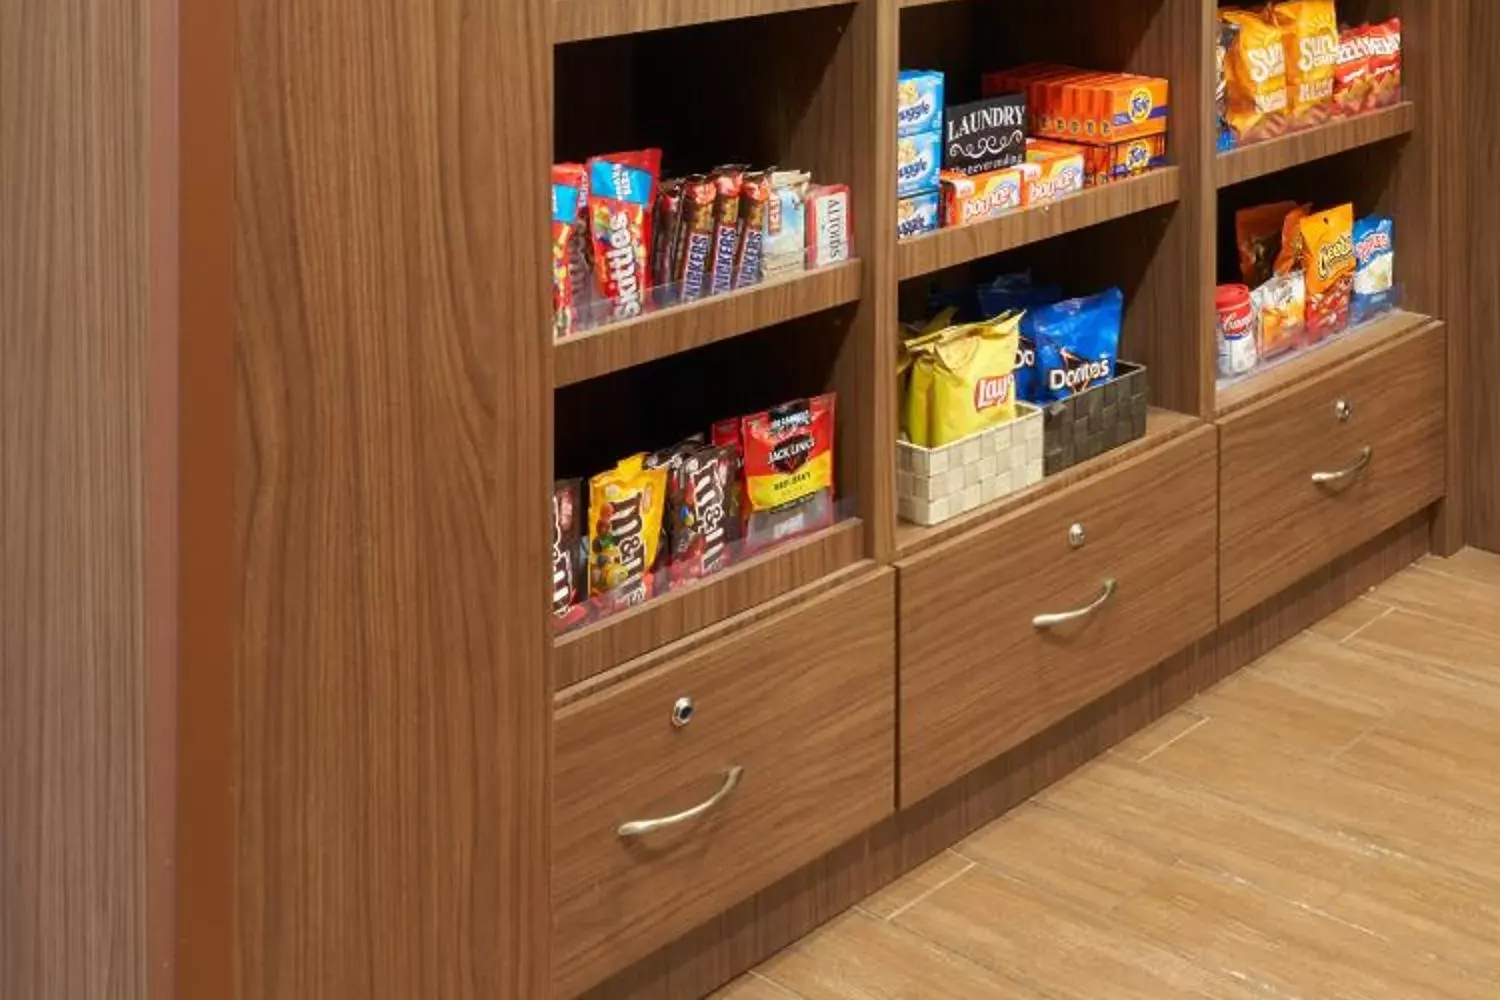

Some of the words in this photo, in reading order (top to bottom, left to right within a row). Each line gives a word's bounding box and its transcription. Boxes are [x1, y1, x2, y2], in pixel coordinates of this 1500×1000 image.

[948, 104, 1026, 142] LAUNDRY
[713, 227, 738, 296] NICKERS
[827, 199, 842, 261] ALTOIDS
[607, 211, 641, 318] Skittles
[684, 234, 710, 300] NICKERS
[1050, 358, 1109, 390] Doritos
